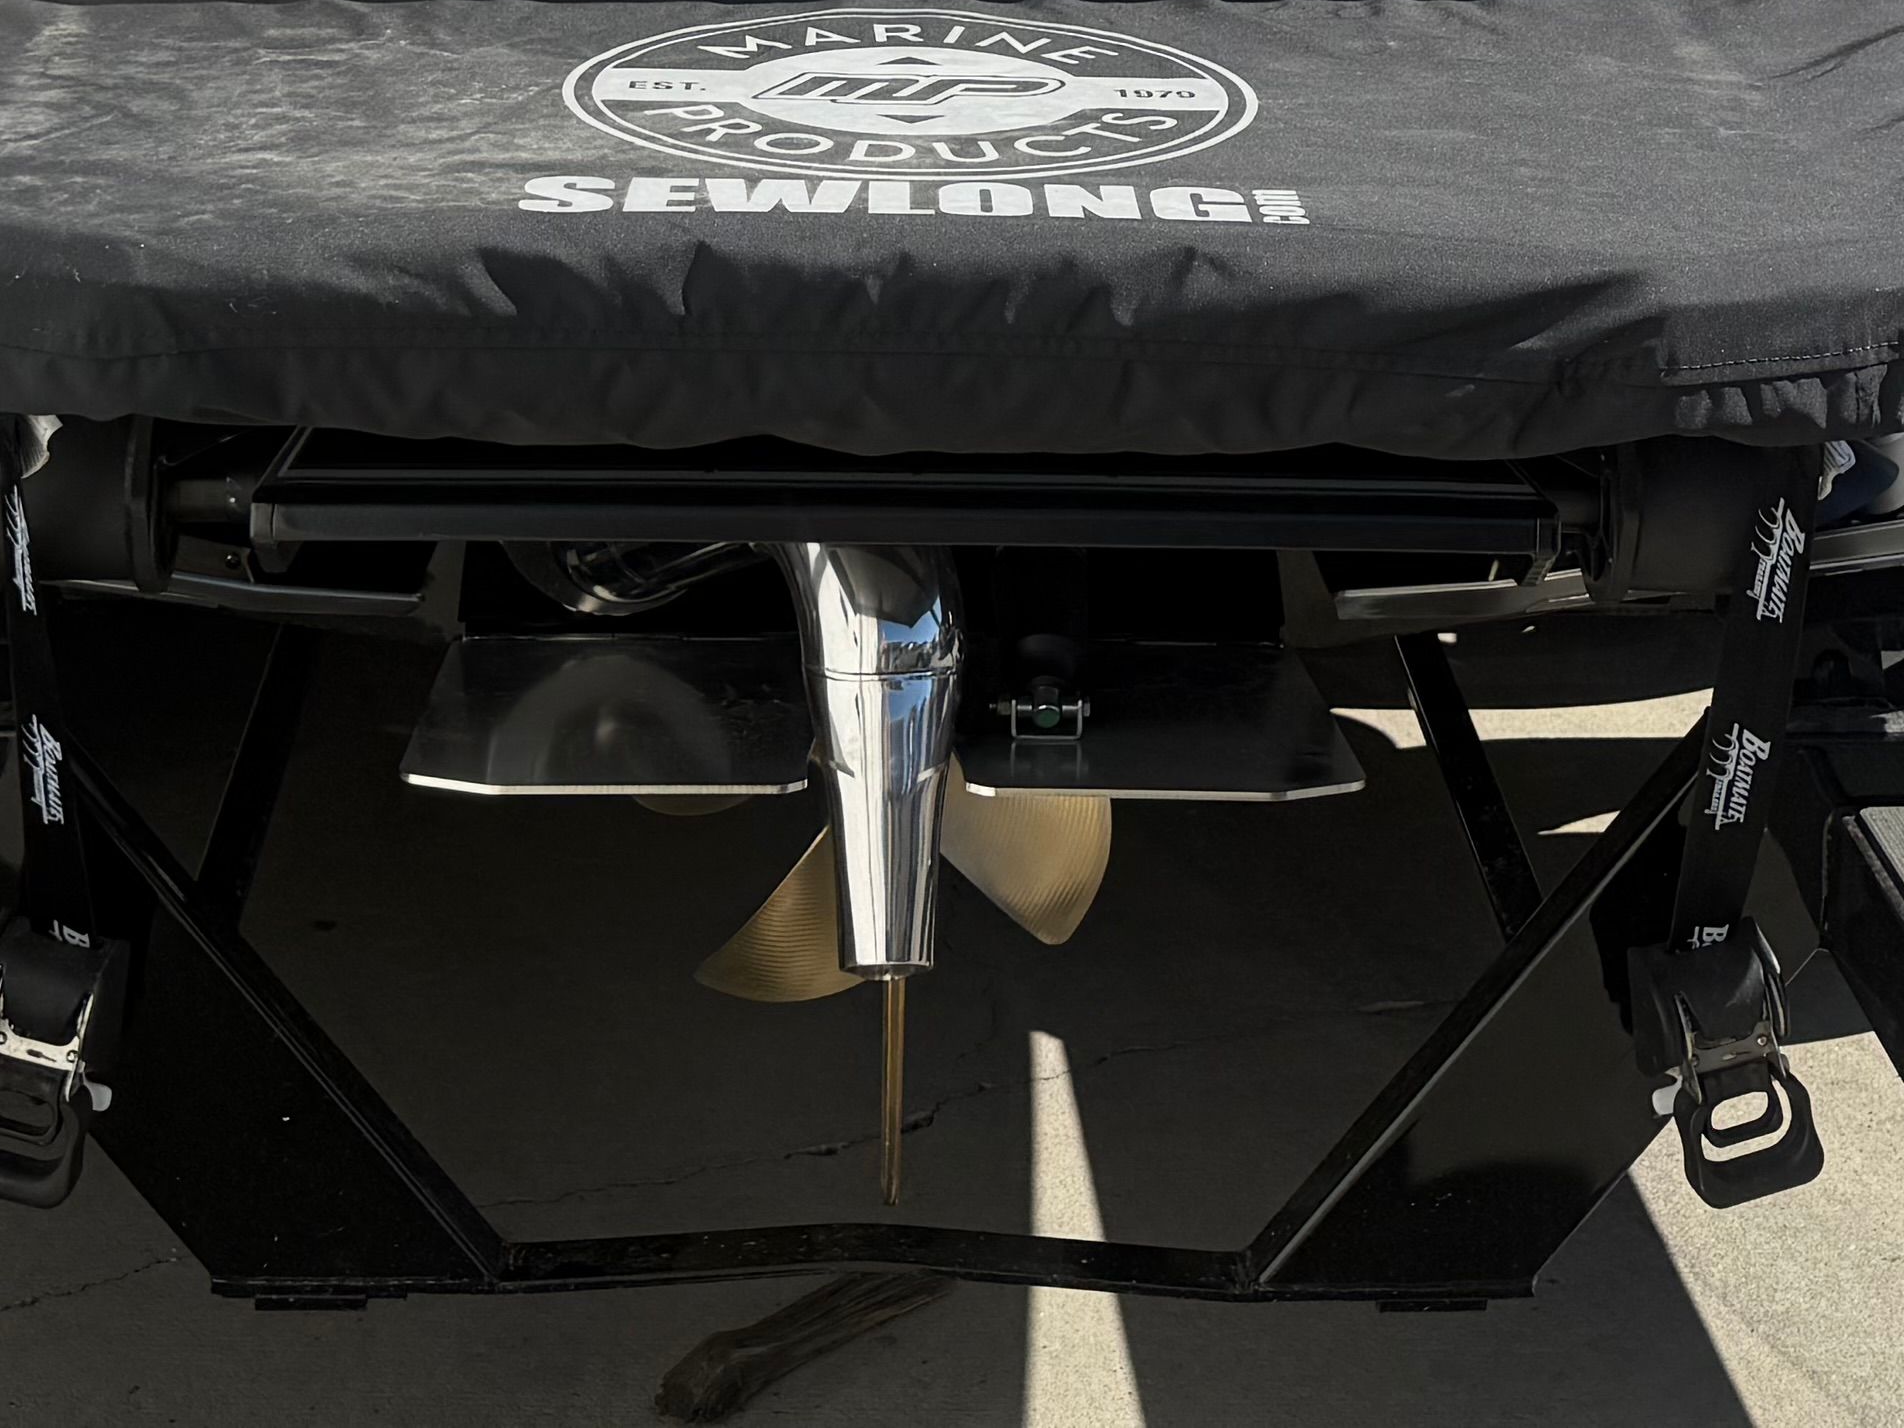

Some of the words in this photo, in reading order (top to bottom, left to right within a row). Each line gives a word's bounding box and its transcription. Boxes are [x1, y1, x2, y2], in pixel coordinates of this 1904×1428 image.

[697, 23, 1120, 67] MARINE
[627, 79, 708, 93] EST.
[644, 100, 1179, 164] PRODUCTS
[518, 176, 1253, 225] SEWLONG
[1726, 728, 1772, 824] BOATMATE
